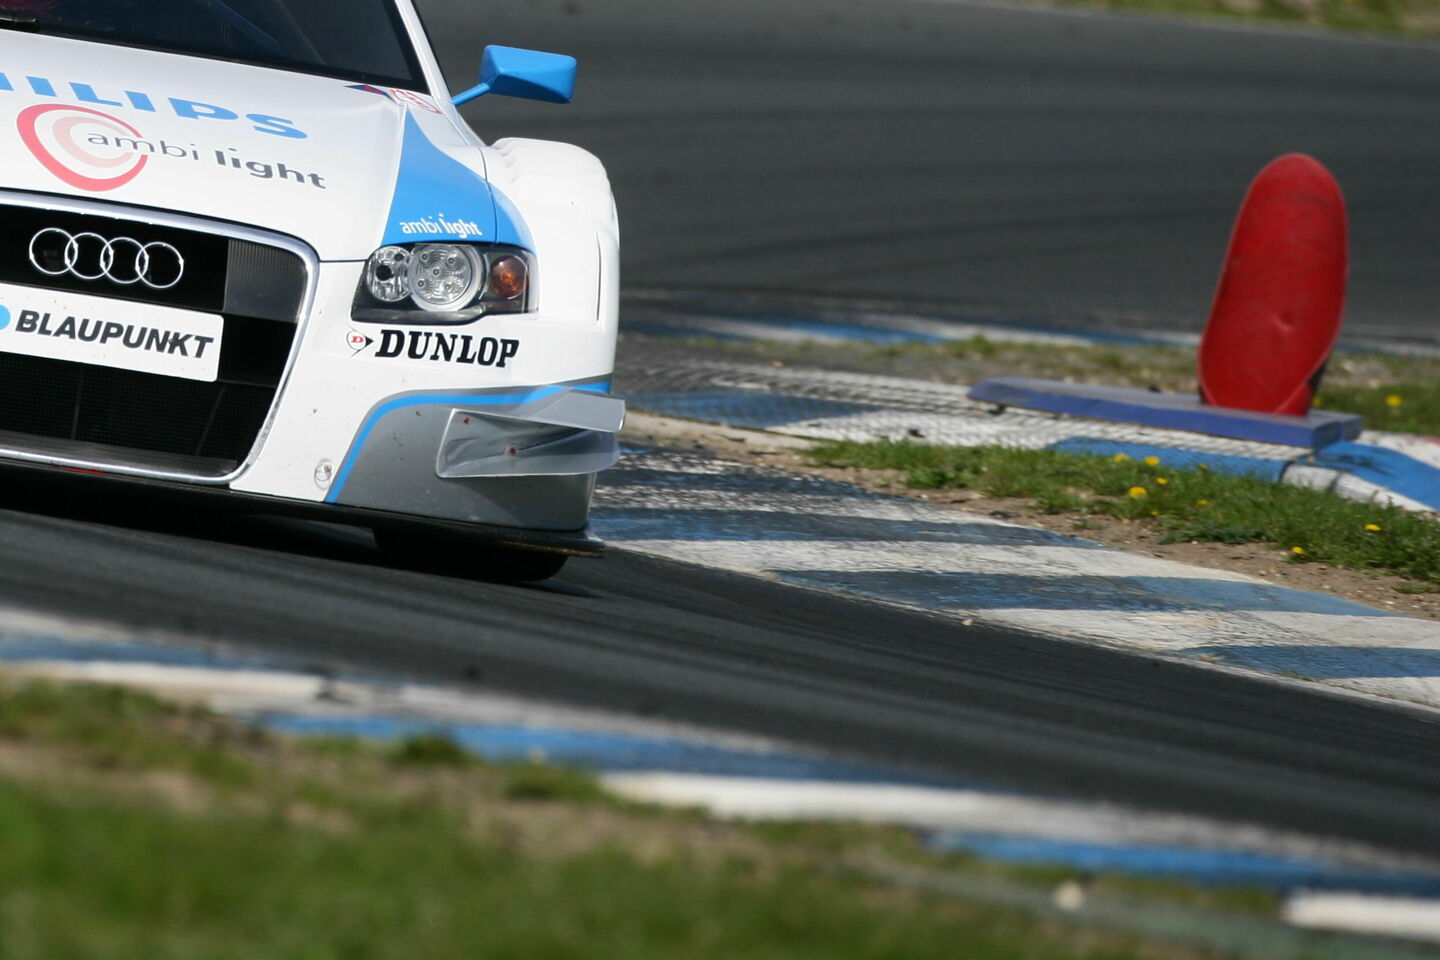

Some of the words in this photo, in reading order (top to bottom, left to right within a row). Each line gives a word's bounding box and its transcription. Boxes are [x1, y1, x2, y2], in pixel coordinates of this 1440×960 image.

[87, 132, 199, 161] ambi
[214, 147, 327, 190] light
[399, 215, 441, 235] ambi
[438, 213, 484, 239] light
[14, 309, 215, 359] BLAUPUNKT
[374, 328, 520, 369] DUNLOP
